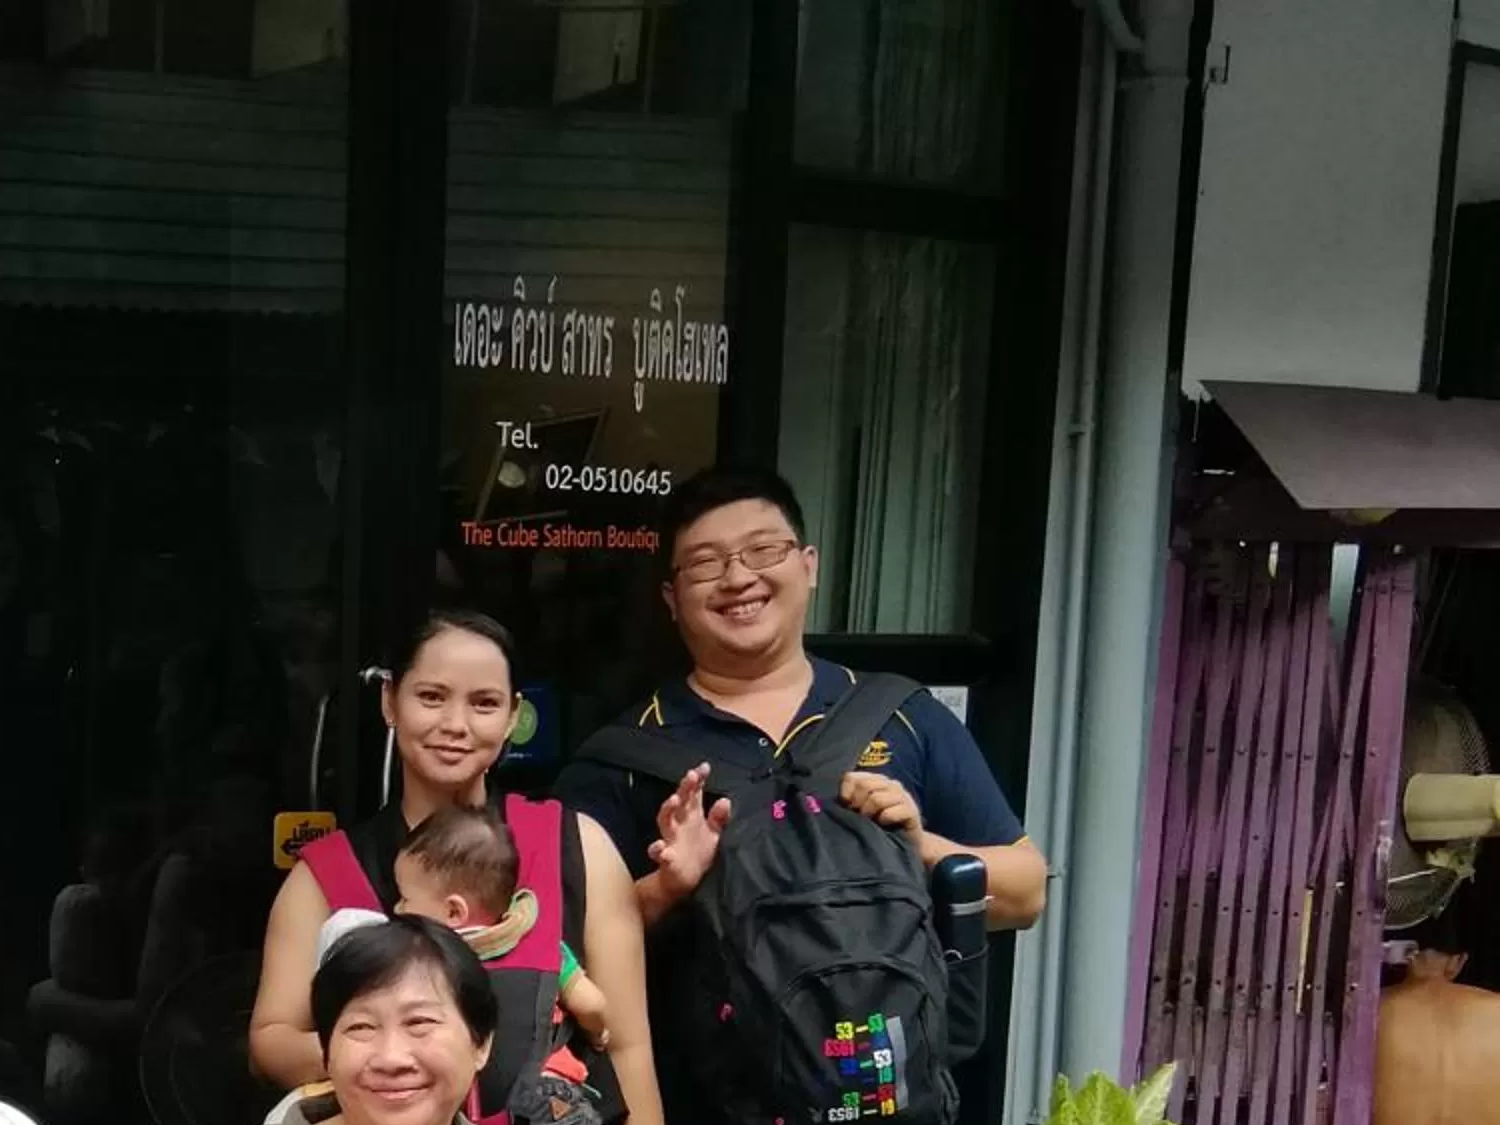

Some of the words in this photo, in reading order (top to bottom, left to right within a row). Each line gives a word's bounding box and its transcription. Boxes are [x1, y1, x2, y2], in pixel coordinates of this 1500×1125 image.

[454, 303, 503, 368] เดอะ
[561, 308, 616, 379] สาทร
[495, 420, 539, 449] Tel.
[545, 464, 672, 495] 02-0510645
[461, 521, 494, 547] The
[497, 522, 539, 548] Cube
[543, 523, 603, 548] Sathorn
